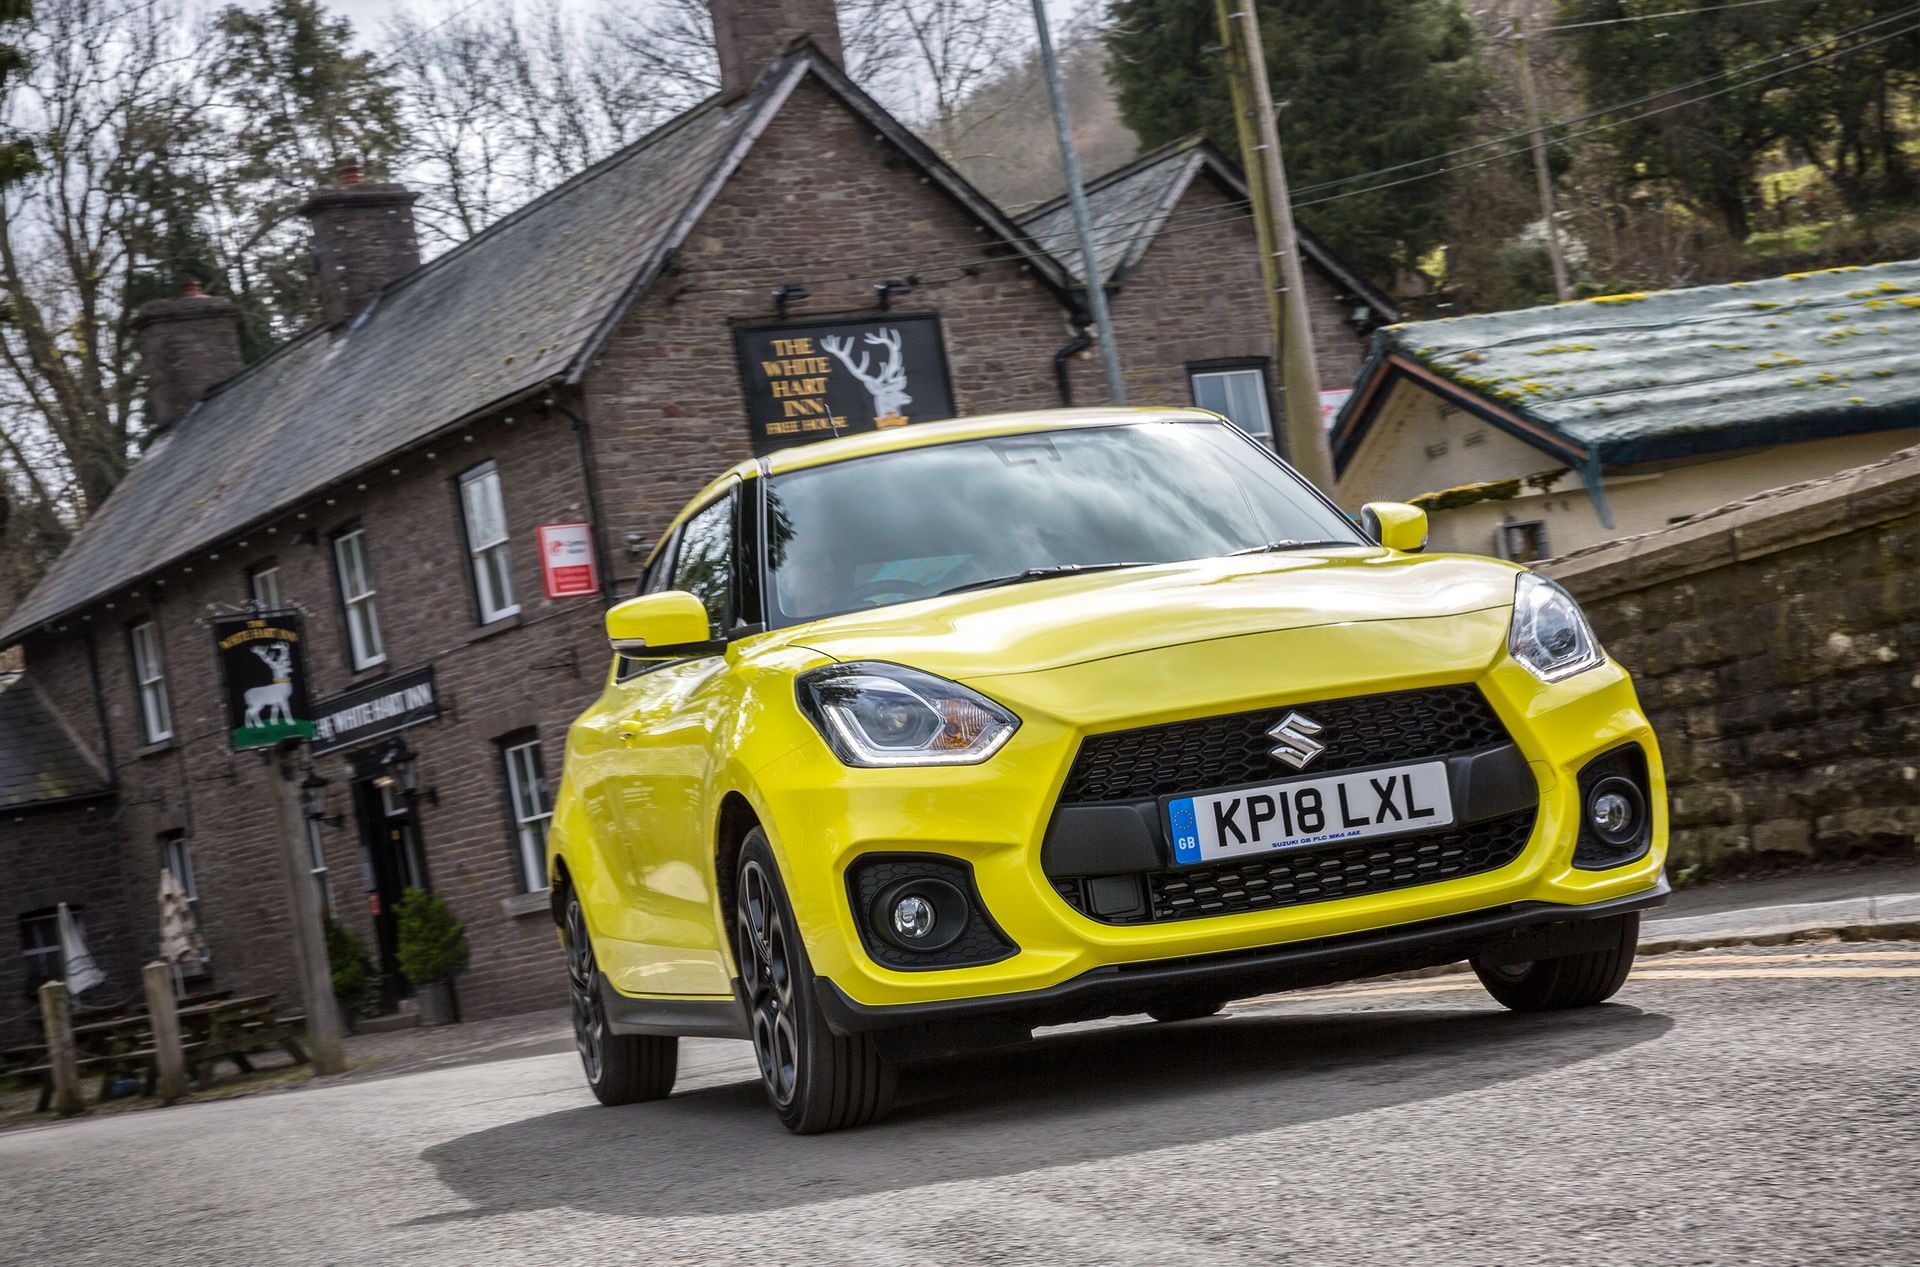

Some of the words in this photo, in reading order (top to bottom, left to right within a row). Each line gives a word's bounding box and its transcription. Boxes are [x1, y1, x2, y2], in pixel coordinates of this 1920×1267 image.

[770, 338, 815, 356] THE
[761, 357, 832, 377] WHITE
[770, 377, 829, 398] HART
[783, 398, 825, 417] INN
[331, 702, 371, 734] WHITE
[403, 682, 433, 711] INN
[1213, 788, 1325, 847] KP18
[1337, 774, 1434, 828] LXL
[1178, 836, 1196, 850] GB
[1272, 839, 1299, 848] SUZUKI
[1313, 834, 1328, 842] PLC
